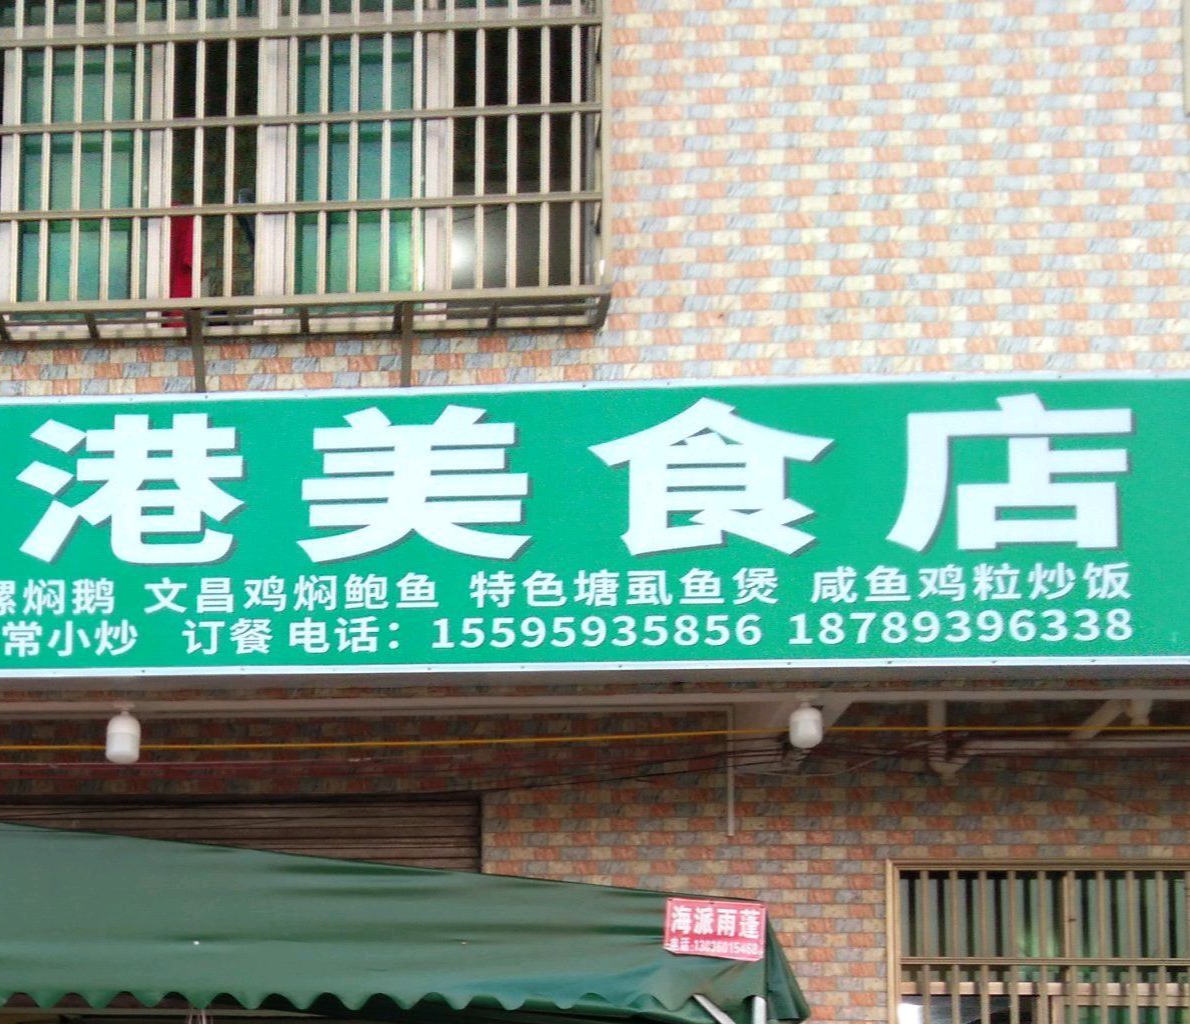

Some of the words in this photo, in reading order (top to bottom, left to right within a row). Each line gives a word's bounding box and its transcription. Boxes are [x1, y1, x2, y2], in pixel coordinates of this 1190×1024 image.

[144, 572, 439, 614] 文昌鸡焖鲍鱼
[469, 568, 779, 608] 特色塘虱鱼煲
[811, 562, 1131, 603] 咸鱼鸡粒炒饭
[432, 613, 762, 649] 15595935856
[788, 608, 1133, 645] 18789396338
